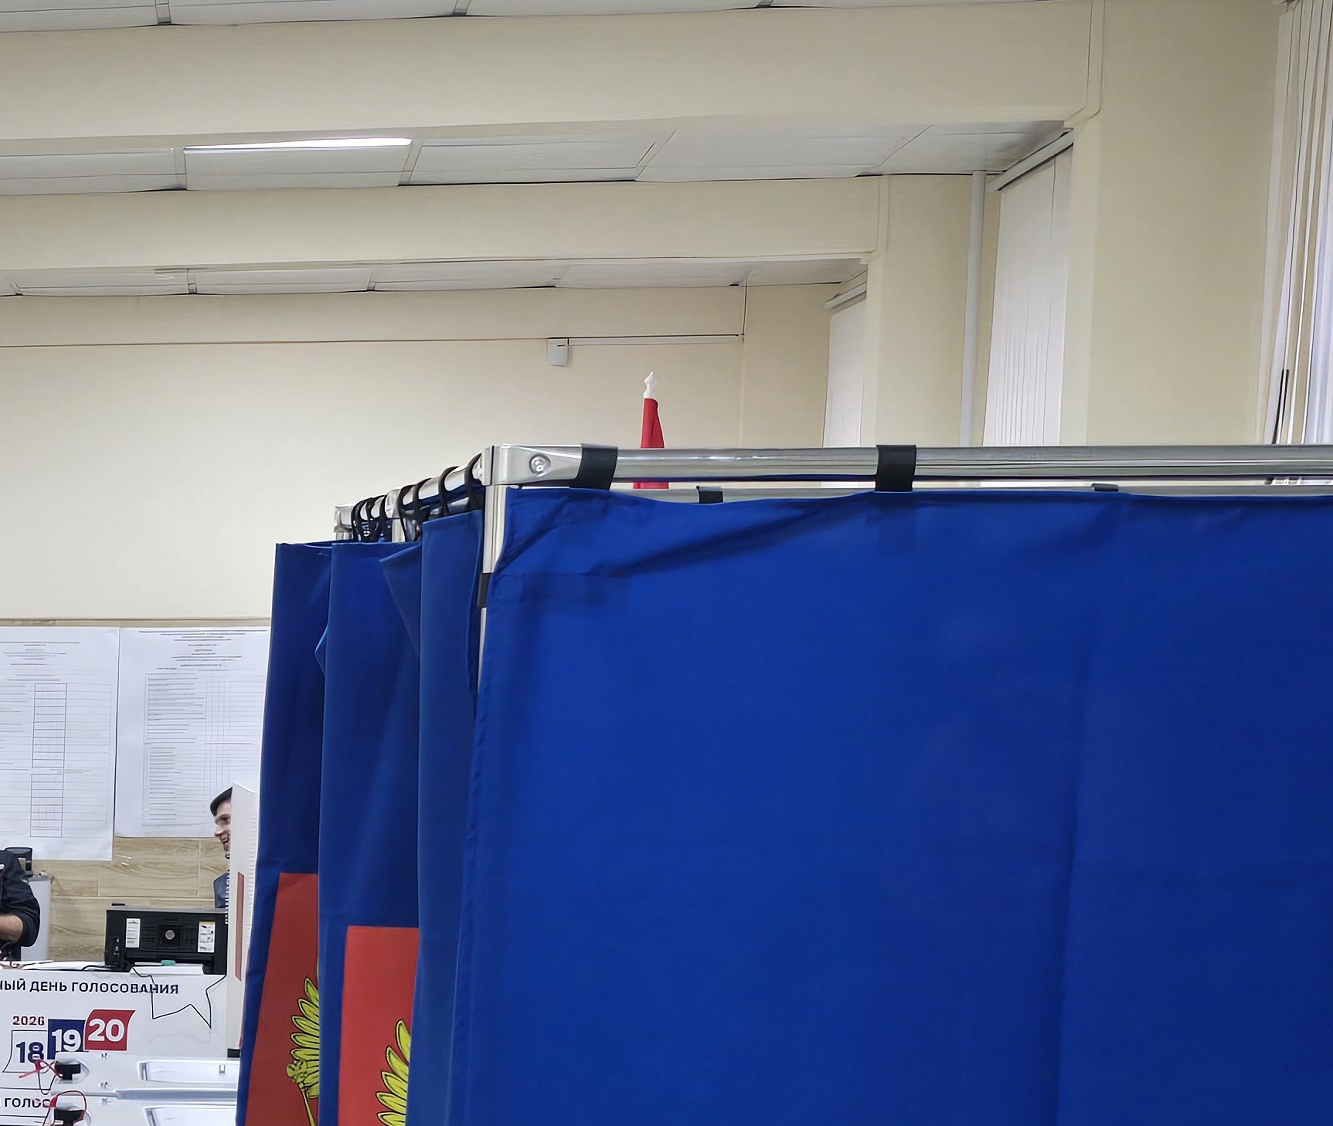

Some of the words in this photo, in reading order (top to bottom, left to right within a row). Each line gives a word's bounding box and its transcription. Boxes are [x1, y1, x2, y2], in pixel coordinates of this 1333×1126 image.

[29, 981, 68, 993] ДЕНЬ
[71, 982, 179, 995] ГОЛОСОВАНИЯ
[12, 1016, 45, 1026] 2026
[15, 1041, 45, 1064] 18
[51, 1029, 82, 1052] 19
[88, 1018, 125, 1042] 20
[4, 1097, 51, 1108] ГОЛОС
